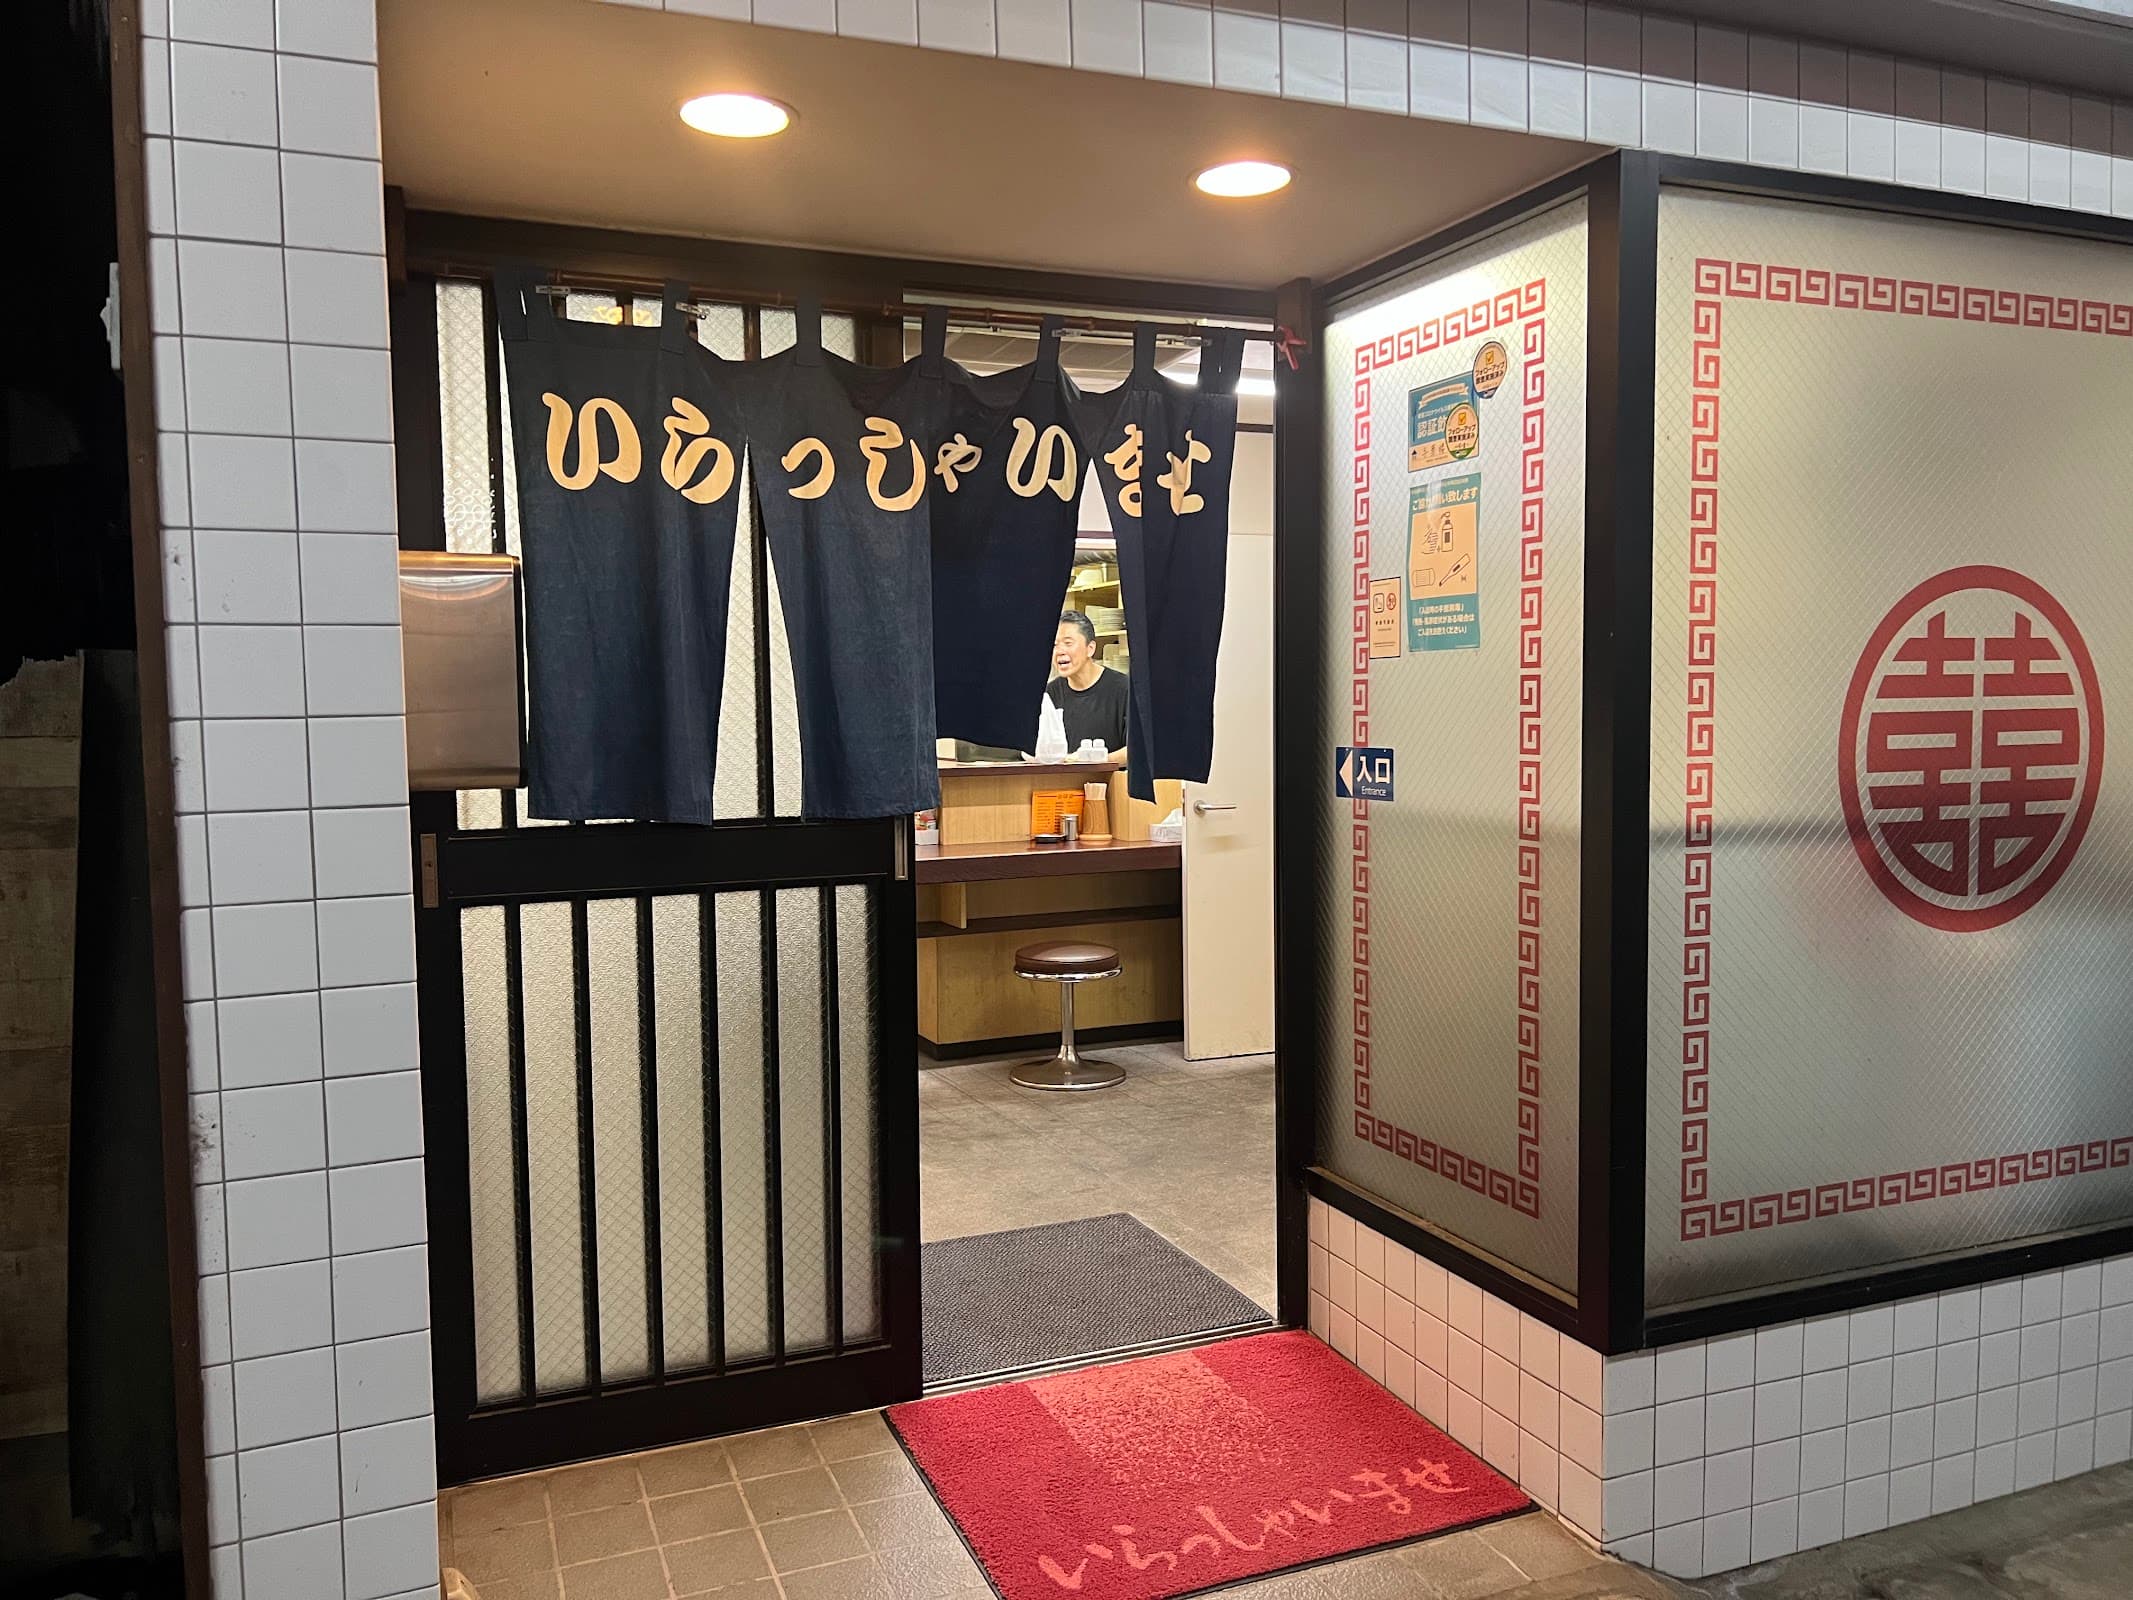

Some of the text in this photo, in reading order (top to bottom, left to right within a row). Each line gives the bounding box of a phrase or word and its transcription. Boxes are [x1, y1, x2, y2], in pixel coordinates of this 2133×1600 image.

[541, 392, 1212, 518] いらっしゃいませ
[1356, 755, 1391, 785] 入口
[1361, 785, 1388, 797] Entrance
[1038, 1459, 1470, 1590] いらっしゃいませ
